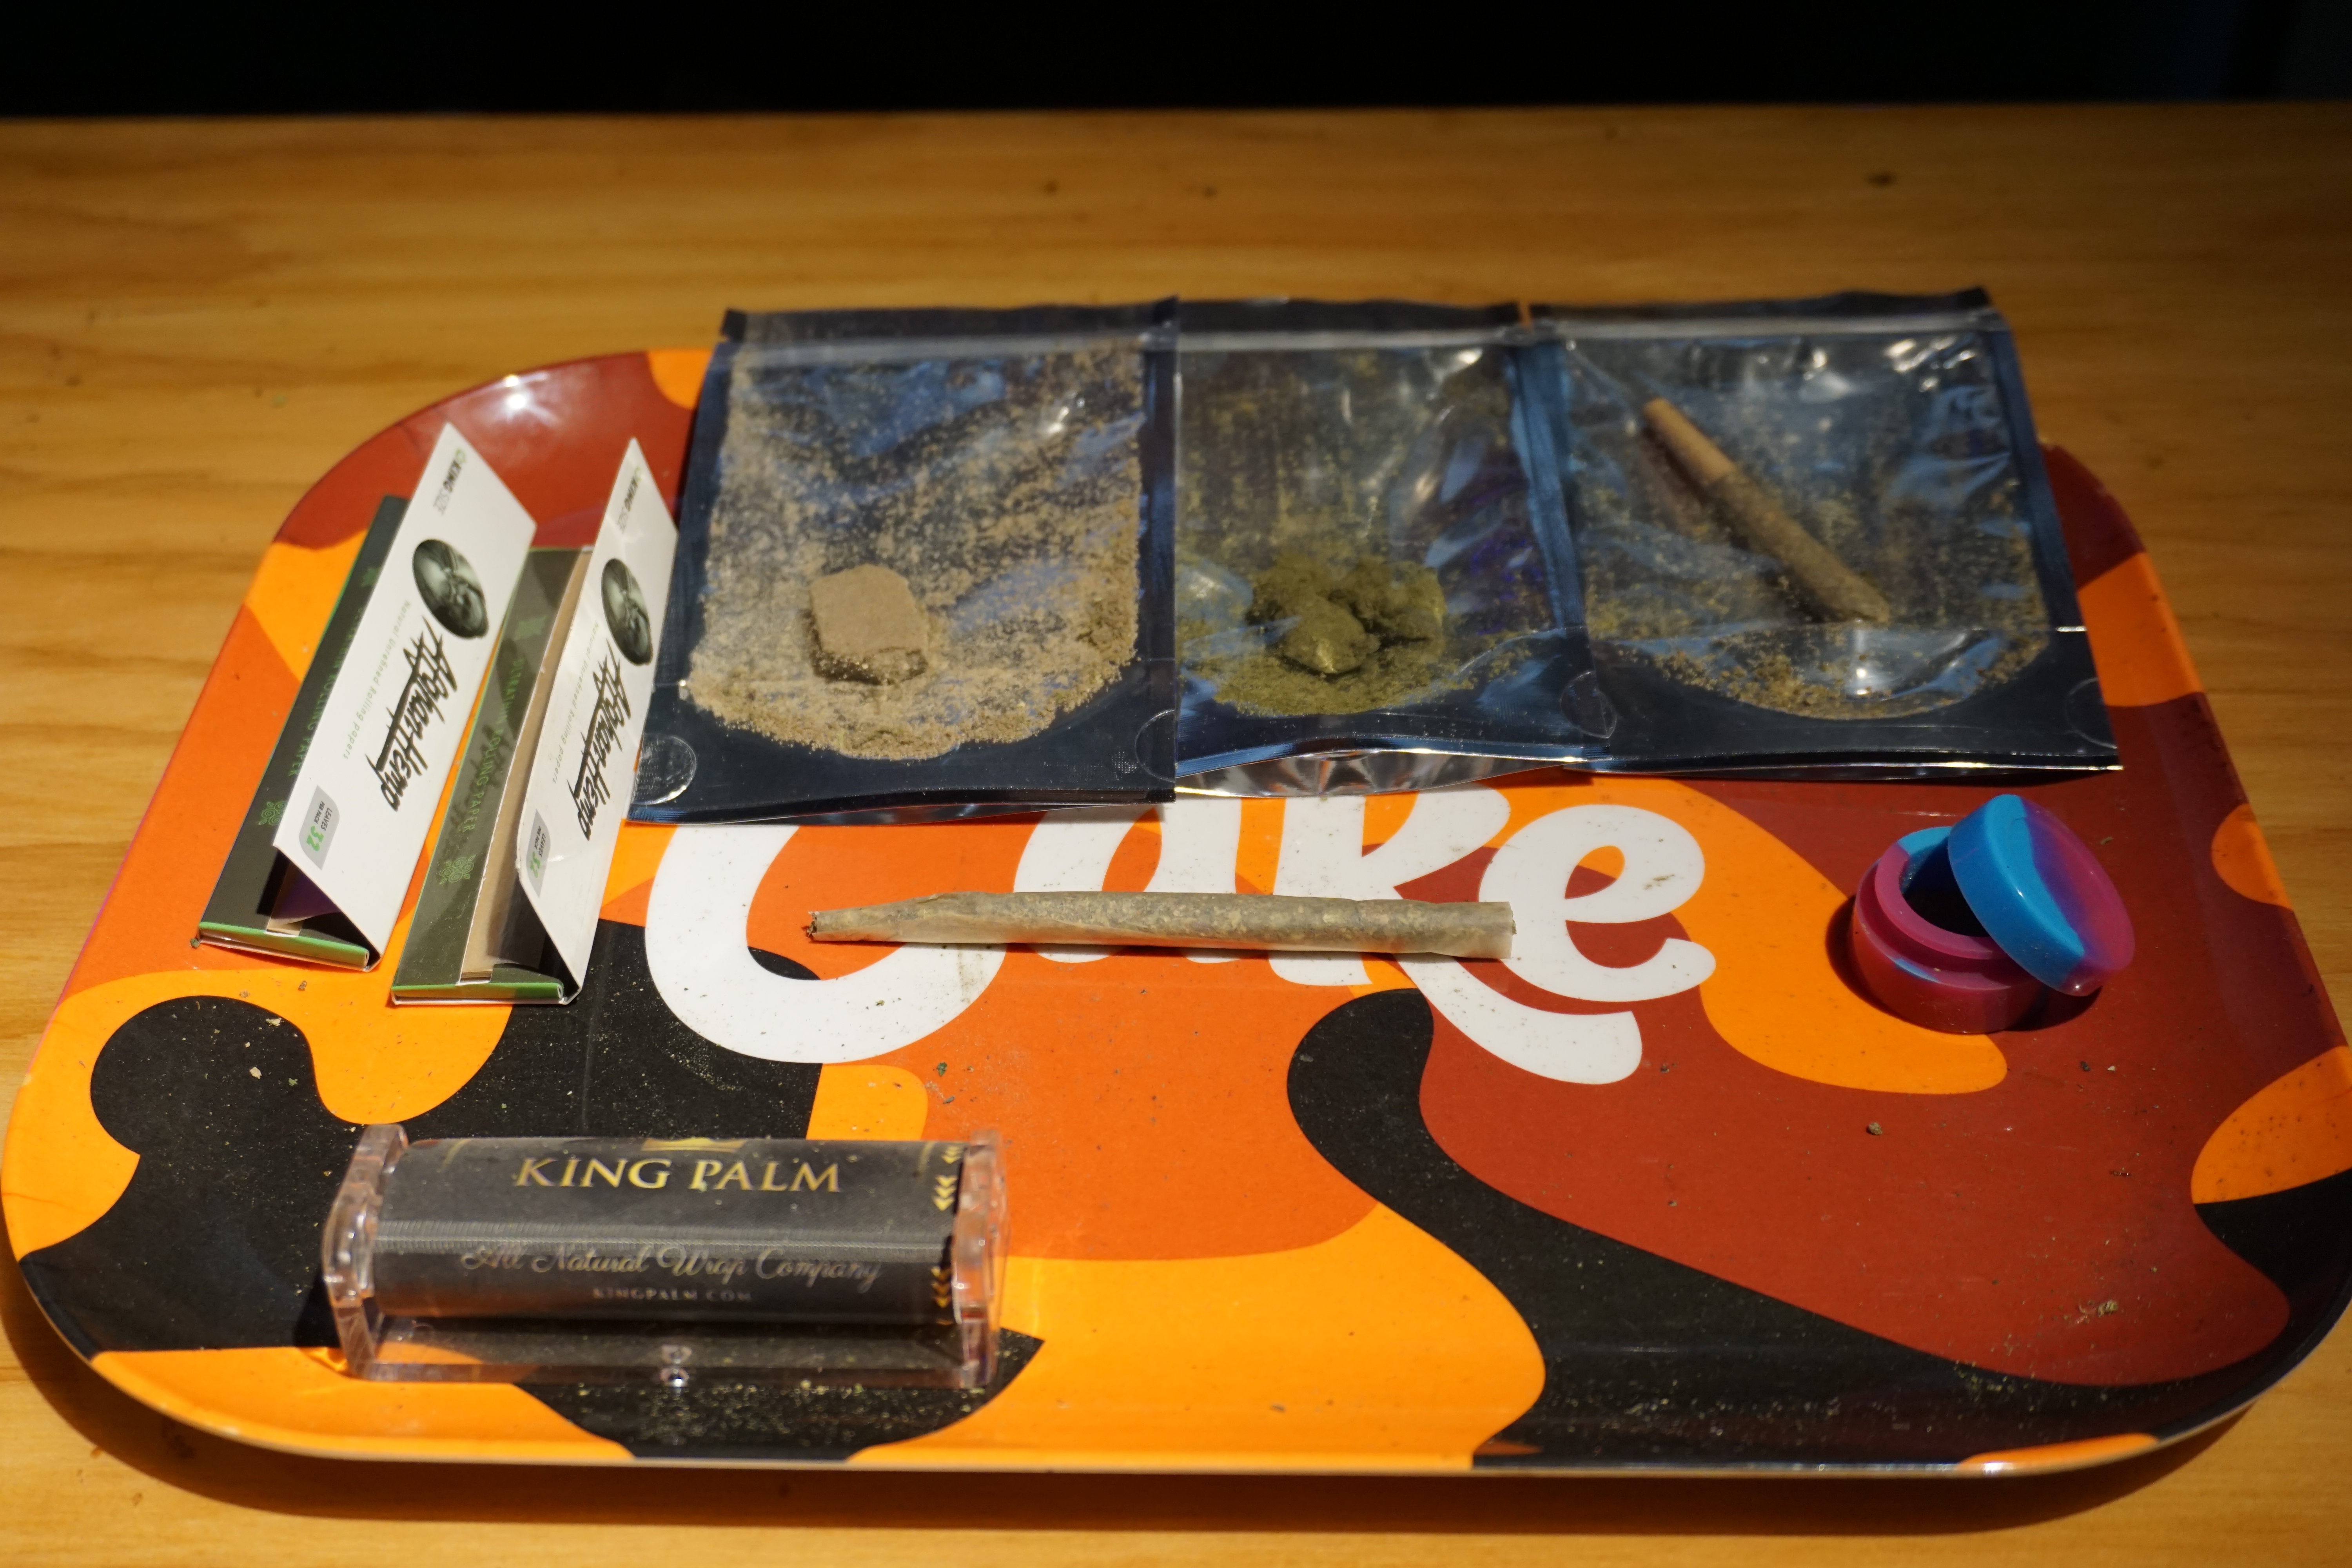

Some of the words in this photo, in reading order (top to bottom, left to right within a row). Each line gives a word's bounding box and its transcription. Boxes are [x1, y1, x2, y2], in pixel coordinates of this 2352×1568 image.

[443, 459, 461, 493] KING
[624, 477, 638, 511] KING
[393, 600, 411, 638] Natural
[586, 621, 599, 660] Natural
[373, 638, 396, 686] Unrefined
[403, 615, 457, 741] Afghan
[570, 660, 588, 709] Unrefined
[356, 687, 377, 722] Rolling
[592, 638, 631, 768] Afghan
[343, 721, 360, 760] papers
[561, 710, 575, 745] Rolling
[477, 728, 505, 786] ROLLING
[553, 744, 564, 784] papers
[314, 810, 323, 824] PACK
[321, 807, 333, 831] LEAVES
[463, 791, 485, 833] PAPER
[306, 826, 324, 851] 32
[538, 833, 546, 857] LEAVES
[530, 851, 540, 878] 32
[514, 1158, 671, 1189] KING
[688, 1159, 840, 1193] PALM
[531, 1243, 650, 1273] Natural
[657, 1247, 746, 1285] Wrap
[755, 1248, 882, 1294] Company
[593, 1286, 752, 1301] KINGPALMCOM
